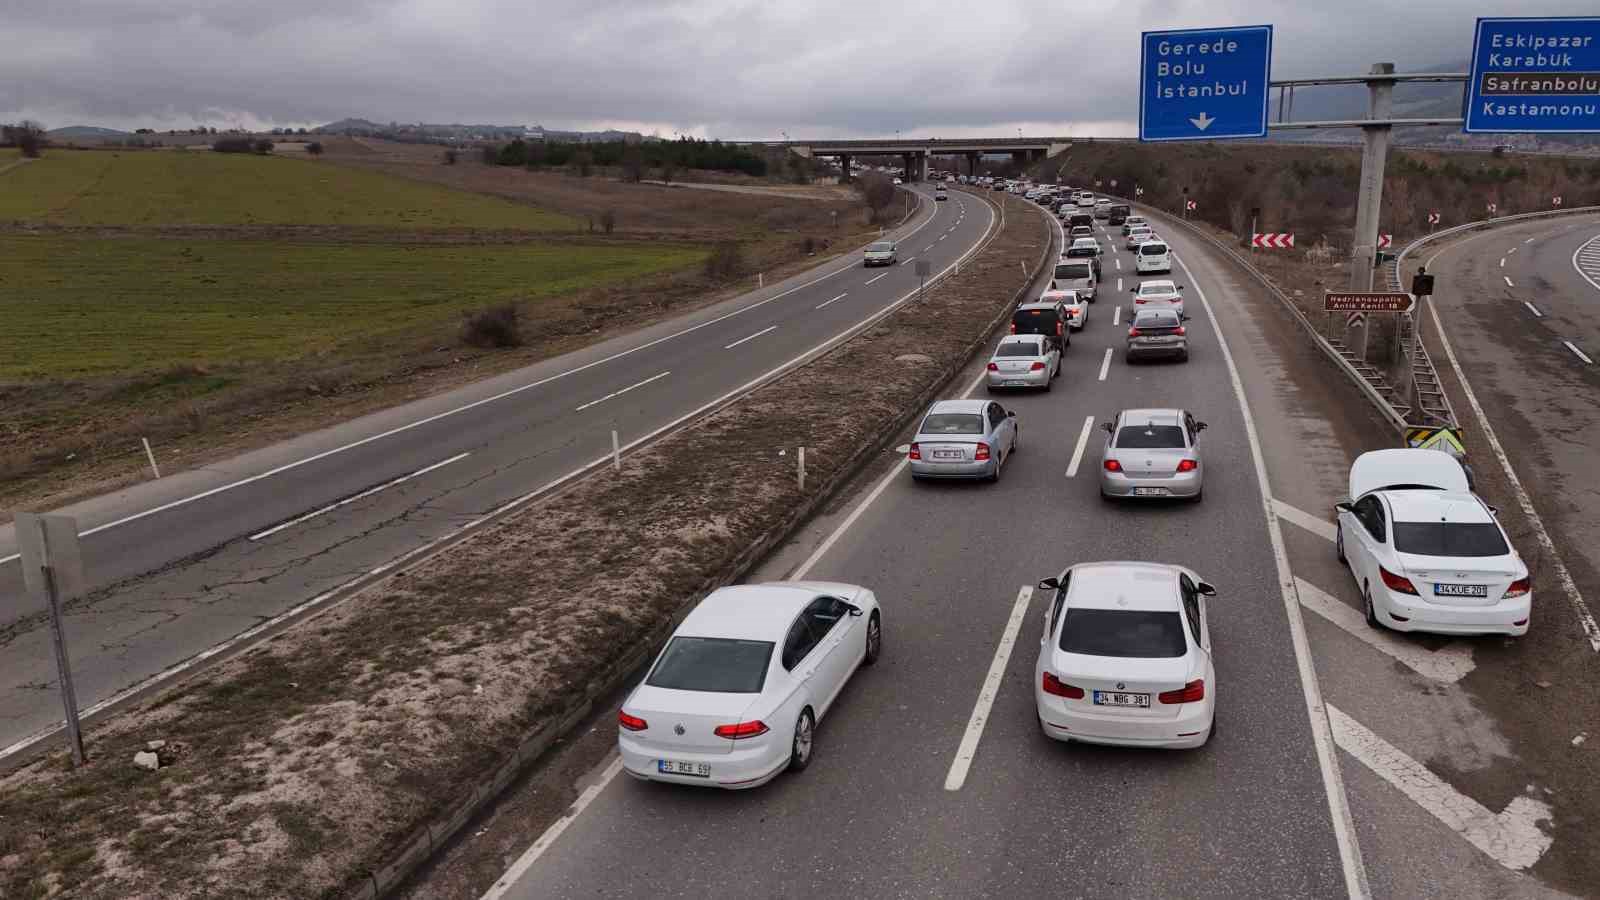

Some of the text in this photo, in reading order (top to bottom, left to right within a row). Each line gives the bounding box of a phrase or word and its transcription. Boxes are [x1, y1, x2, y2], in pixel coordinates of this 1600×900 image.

[1158, 38, 1237, 56] Gerede
[1492, 34, 1592, 50] Eskipazar
[1489, 53, 1572, 67] Karabük
[1157, 61, 1205, 76] Bolu
[1156, 80, 1247, 99] İstanbul
[1487, 77, 1597, 91] Safranbolu
[1483, 102, 1596, 116] Kastamonu
[1450, 585, 1470, 594] KUE
[1100, 693, 1109, 703] 34
